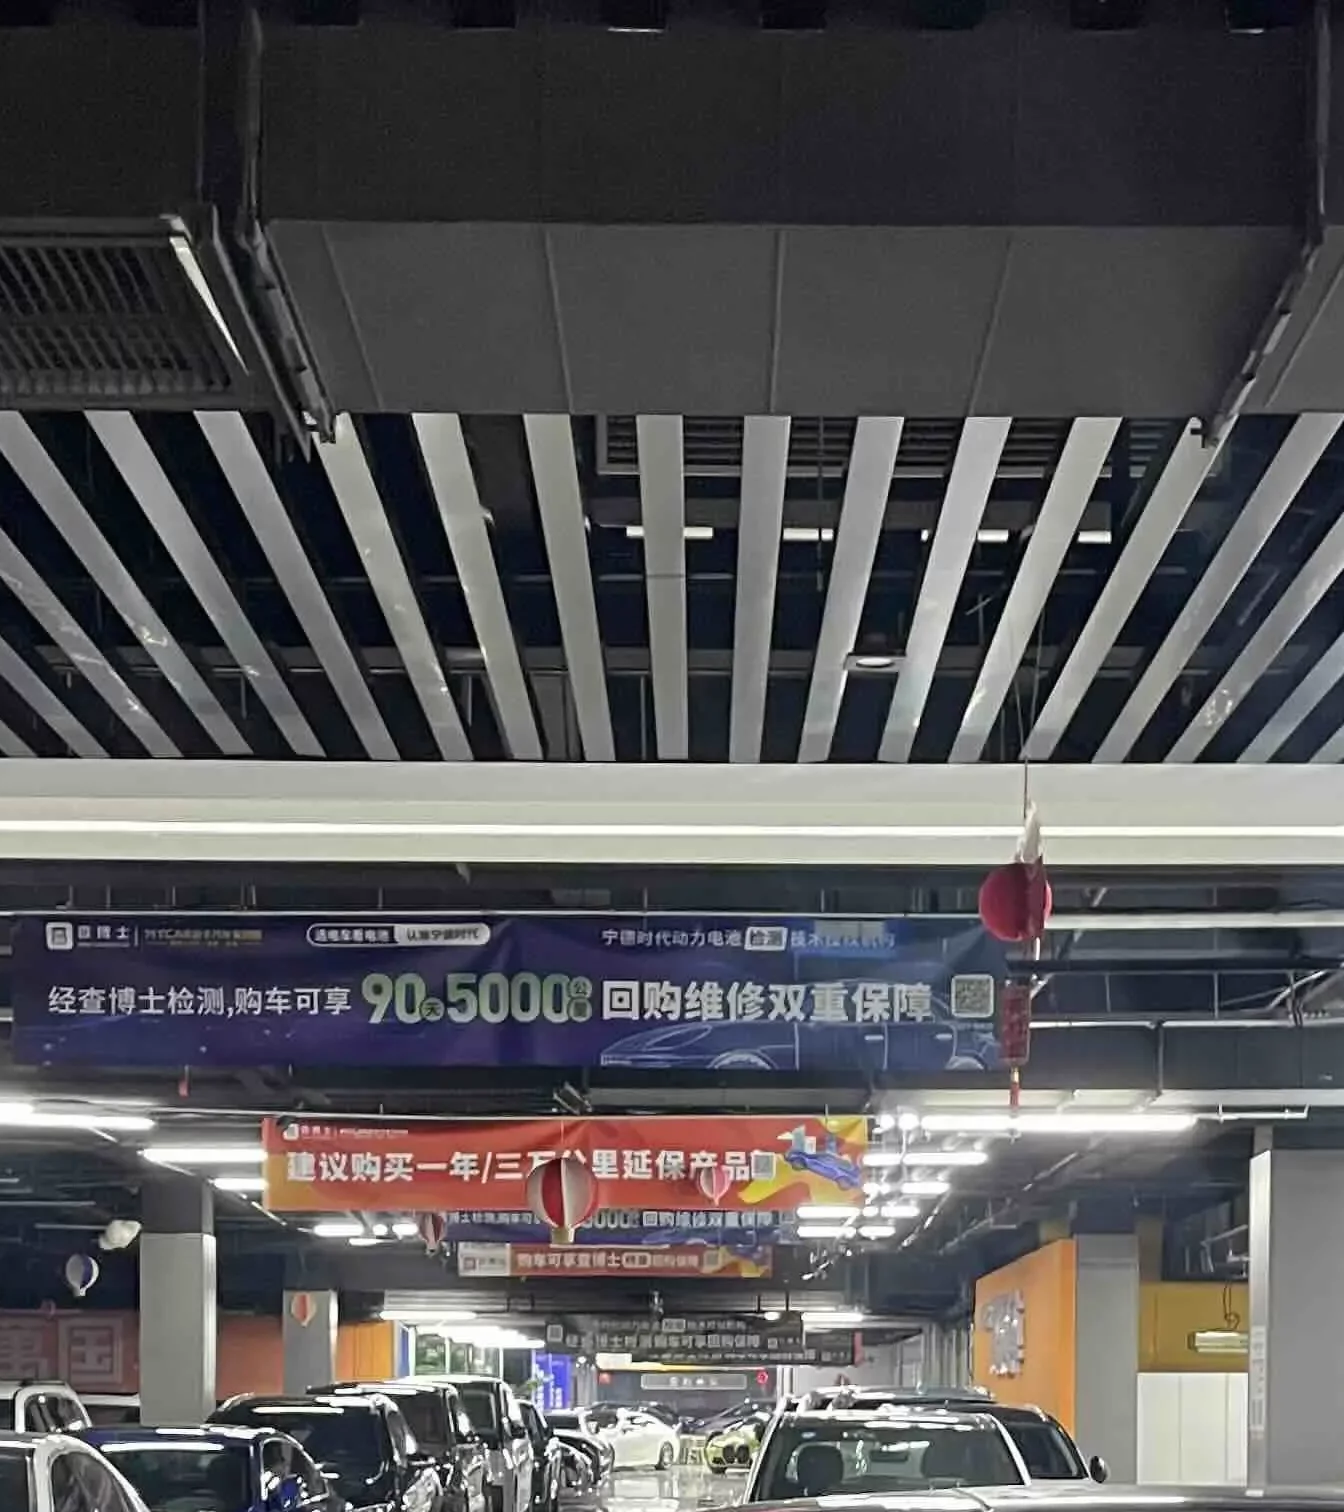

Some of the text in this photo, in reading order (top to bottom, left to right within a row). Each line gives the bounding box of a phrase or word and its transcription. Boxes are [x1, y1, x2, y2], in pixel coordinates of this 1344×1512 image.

[48, 986, 352, 1019] 经查博士检测,购车可享
[602, 979, 936, 1023] 回购维修双重保障
